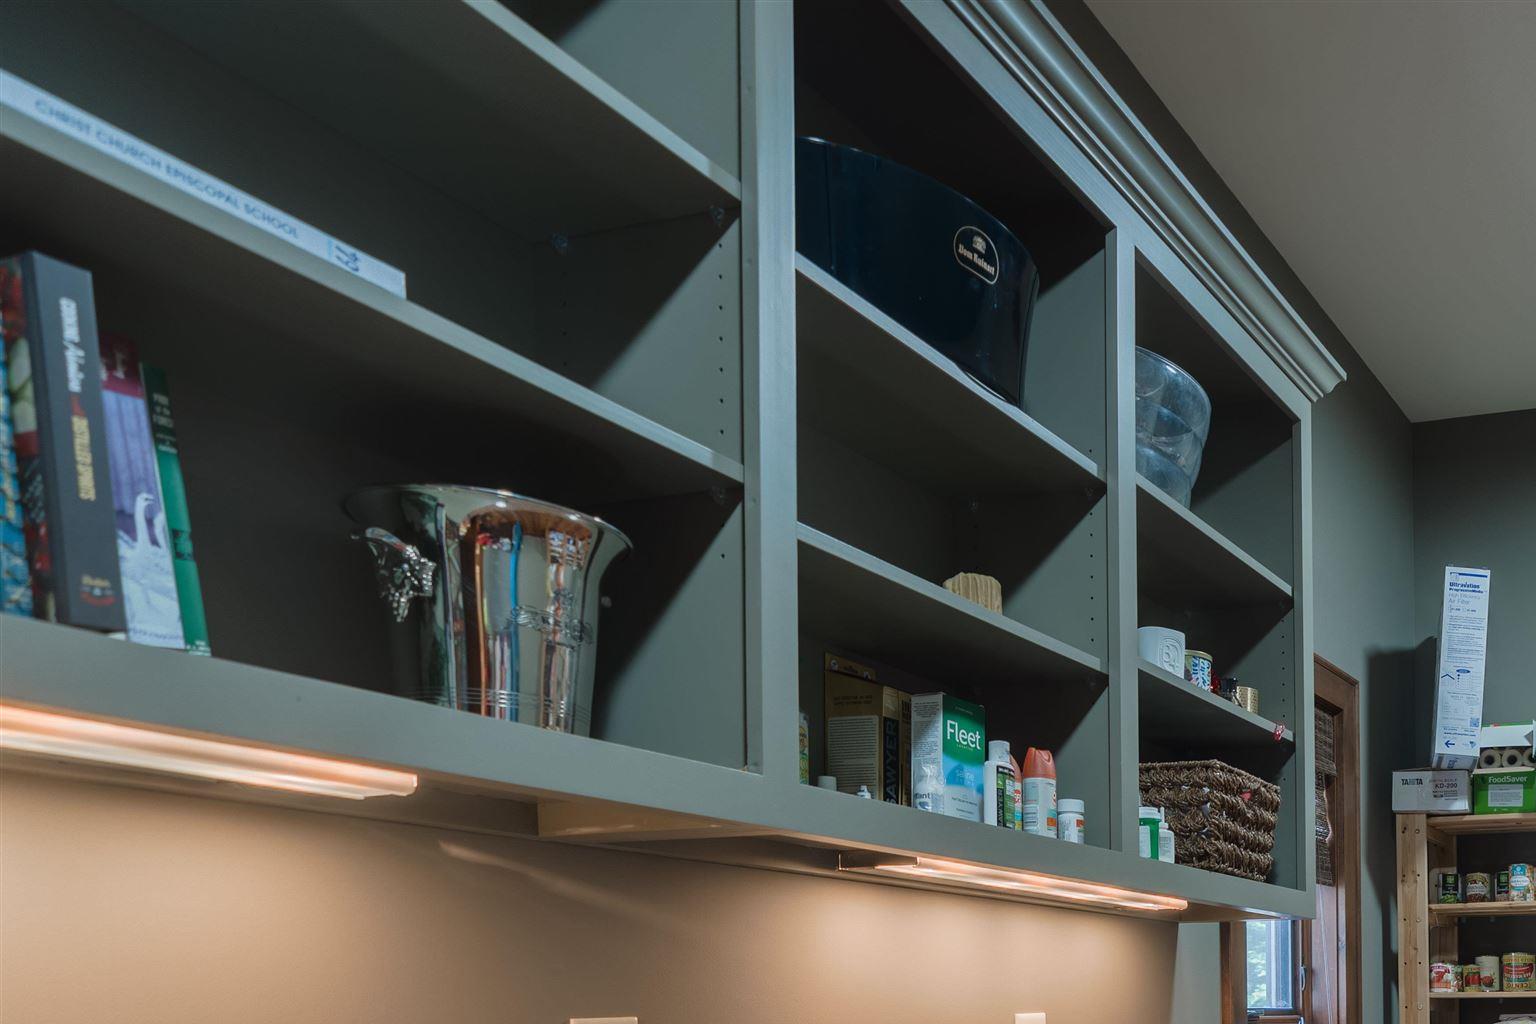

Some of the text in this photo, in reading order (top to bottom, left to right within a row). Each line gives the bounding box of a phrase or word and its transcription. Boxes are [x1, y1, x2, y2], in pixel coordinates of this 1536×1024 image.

[34, 99, 299, 240] CHRIST CHURCH EPISCOPAL SCHOOL
[885, 720, 898, 804] SAWYER
[946, 719, 981, 750] Fleet
[1488, 775, 1528, 784] FoodSaver
